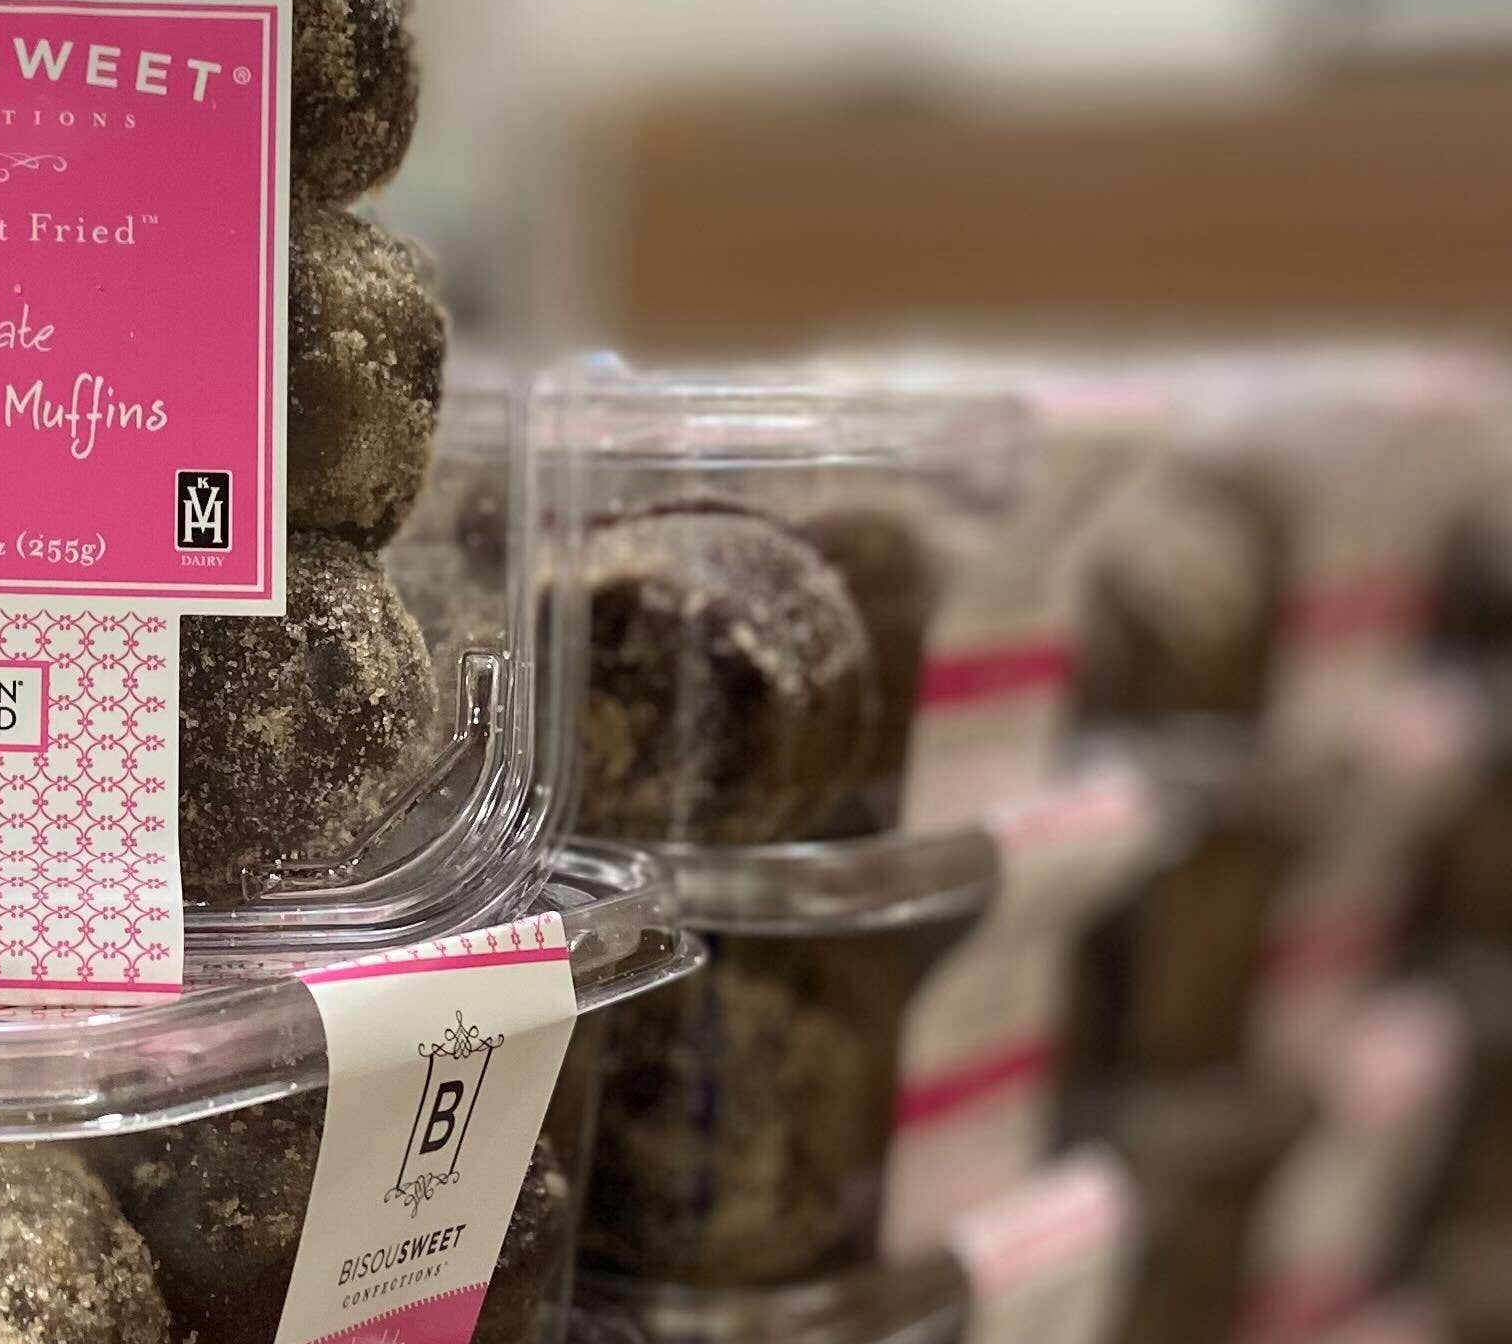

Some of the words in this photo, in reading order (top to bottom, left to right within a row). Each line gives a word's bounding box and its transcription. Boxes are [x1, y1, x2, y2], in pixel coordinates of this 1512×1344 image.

[3, 371, 169, 460] Muffins
[15, 529, 107, 568] (255g)
[180, 554, 226, 568] DAIRY
[418, 1079, 466, 1156] B
[337, 1223, 468, 1287] BISOUSWEET
[341, 1262, 443, 1310] CONFECTIONS
